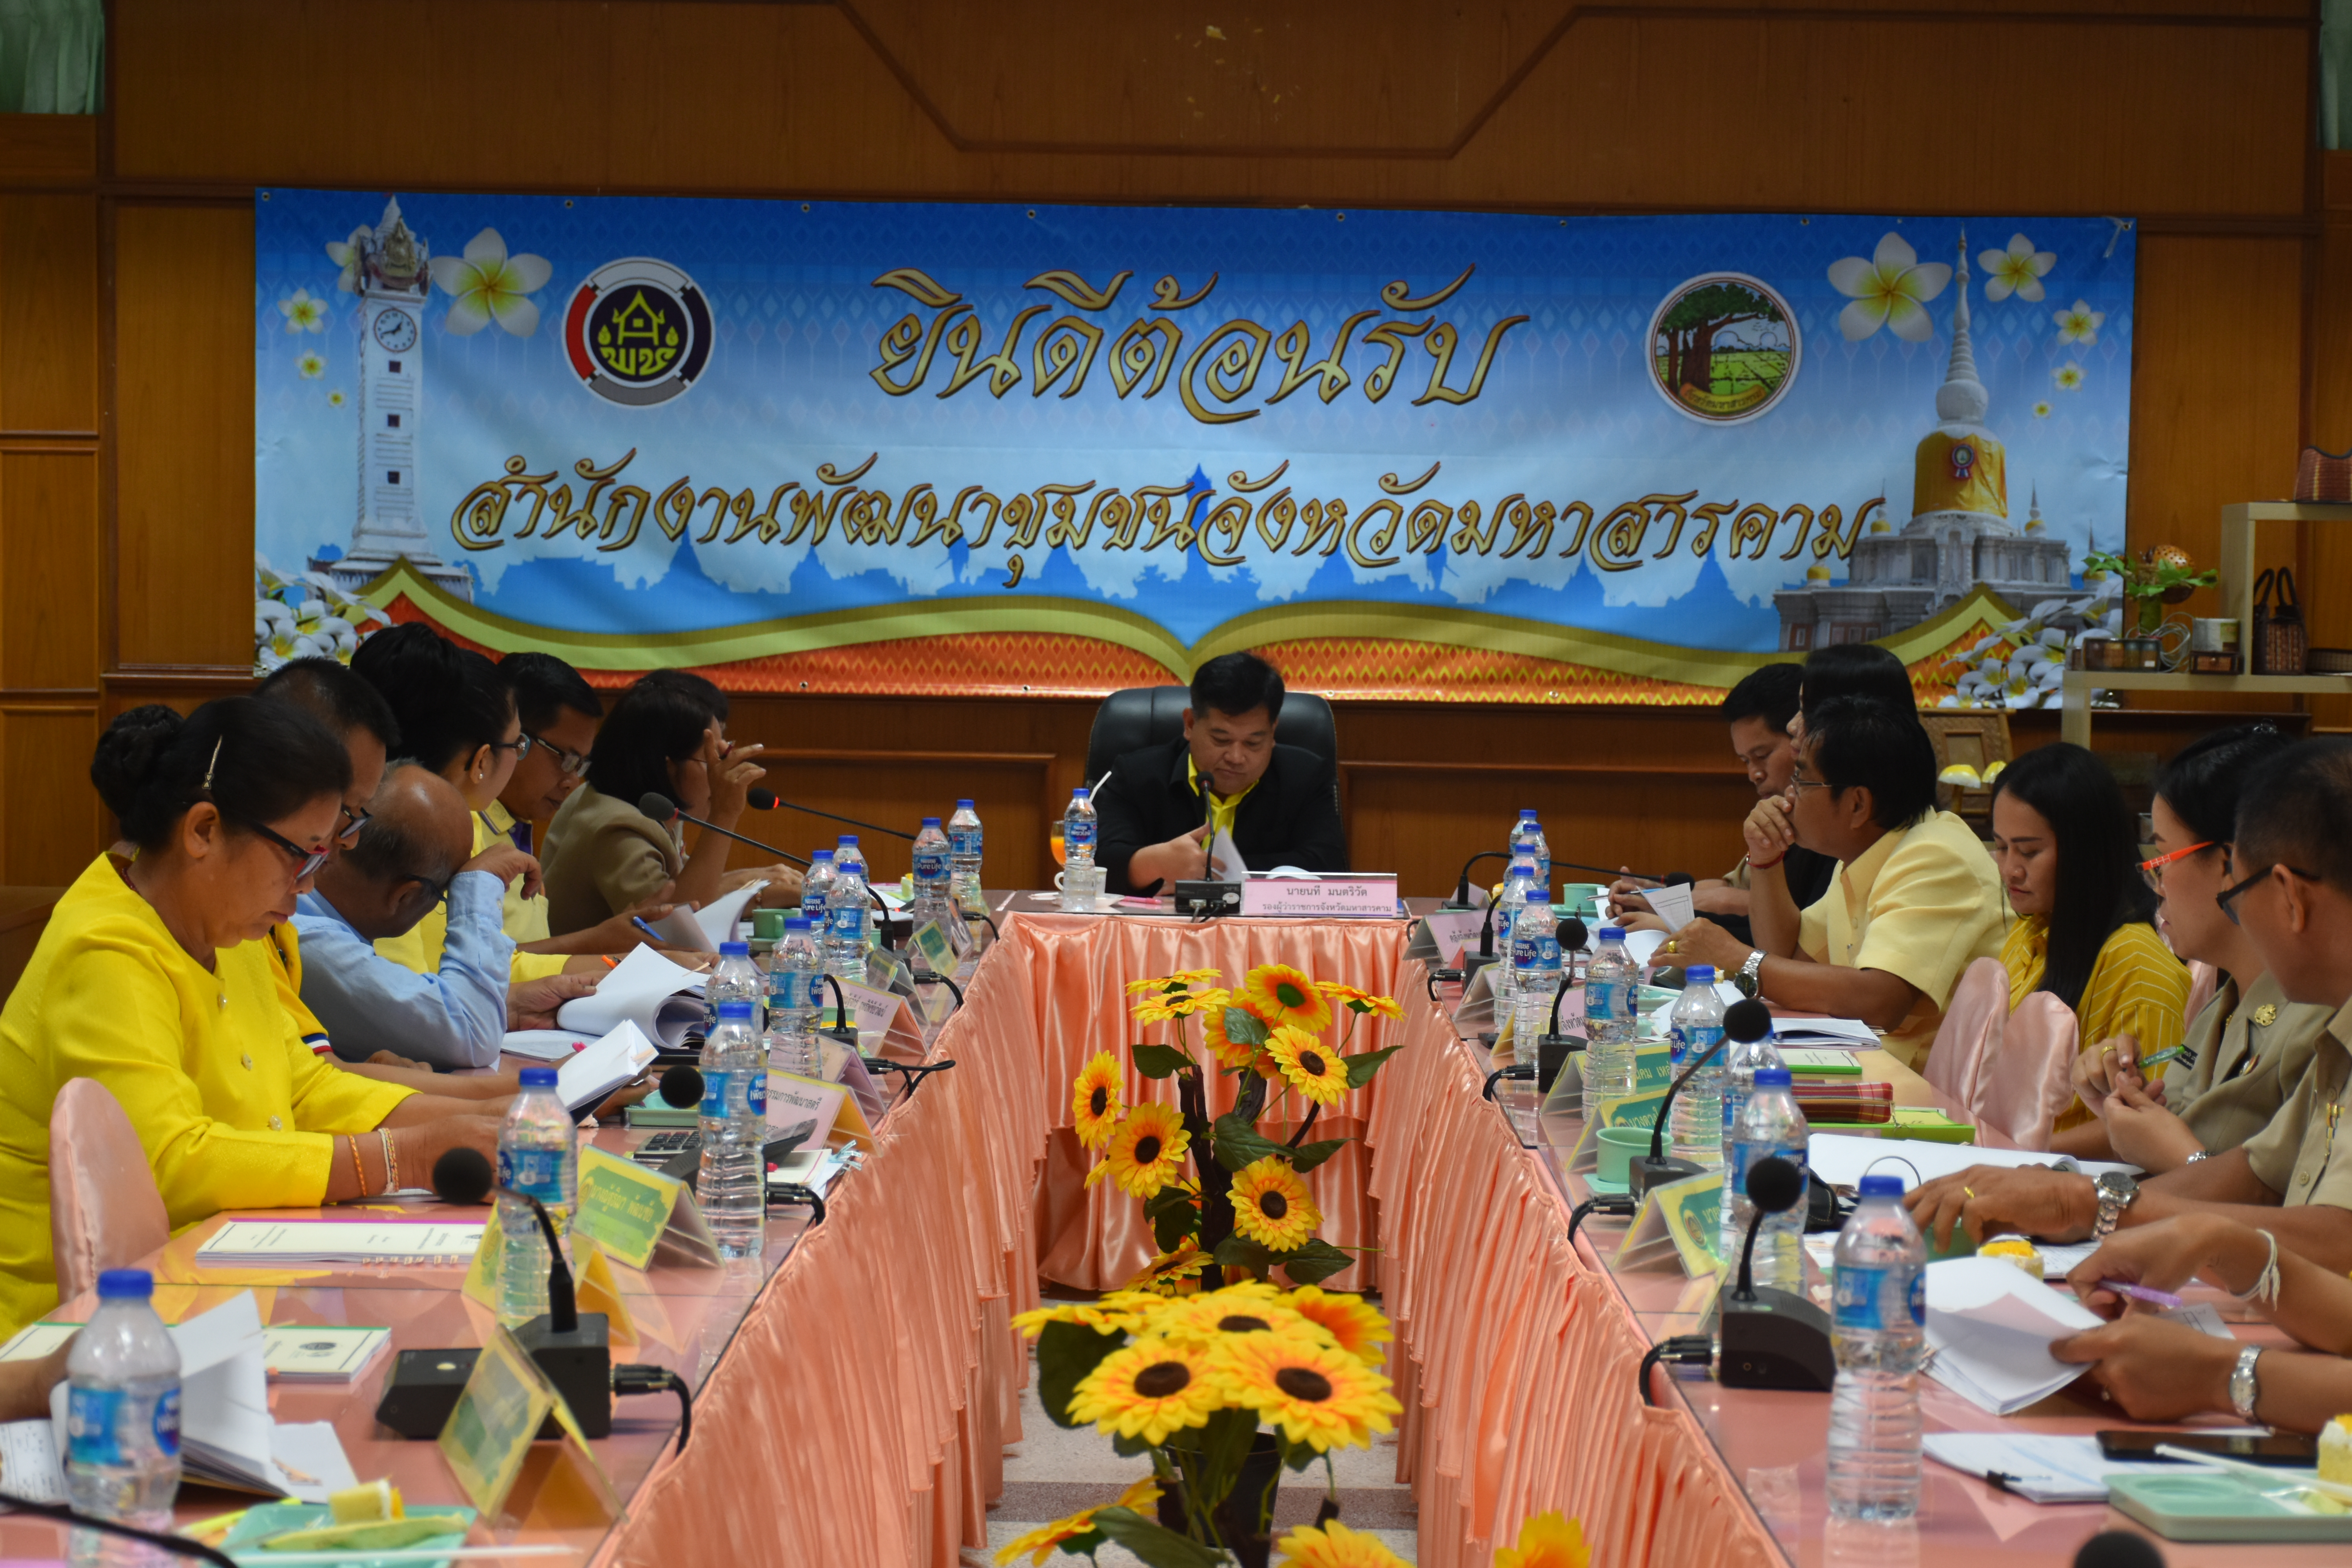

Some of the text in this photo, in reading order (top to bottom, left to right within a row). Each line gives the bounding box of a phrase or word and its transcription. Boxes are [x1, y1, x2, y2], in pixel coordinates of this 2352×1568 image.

[870, 263, 1530, 425] ยินดีต้อนรับ
[451, 447, 1886, 588] สำนักงานพัฒนาชุมชนจังหวัดมหาสารคาม
[1287, 885, 1320, 896] นายนที
[1263, 902, 1392, 913] รองผู้ว่าราชการจังหวัดมหาสารคาม
[1524, 949, 1537, 959] Life
